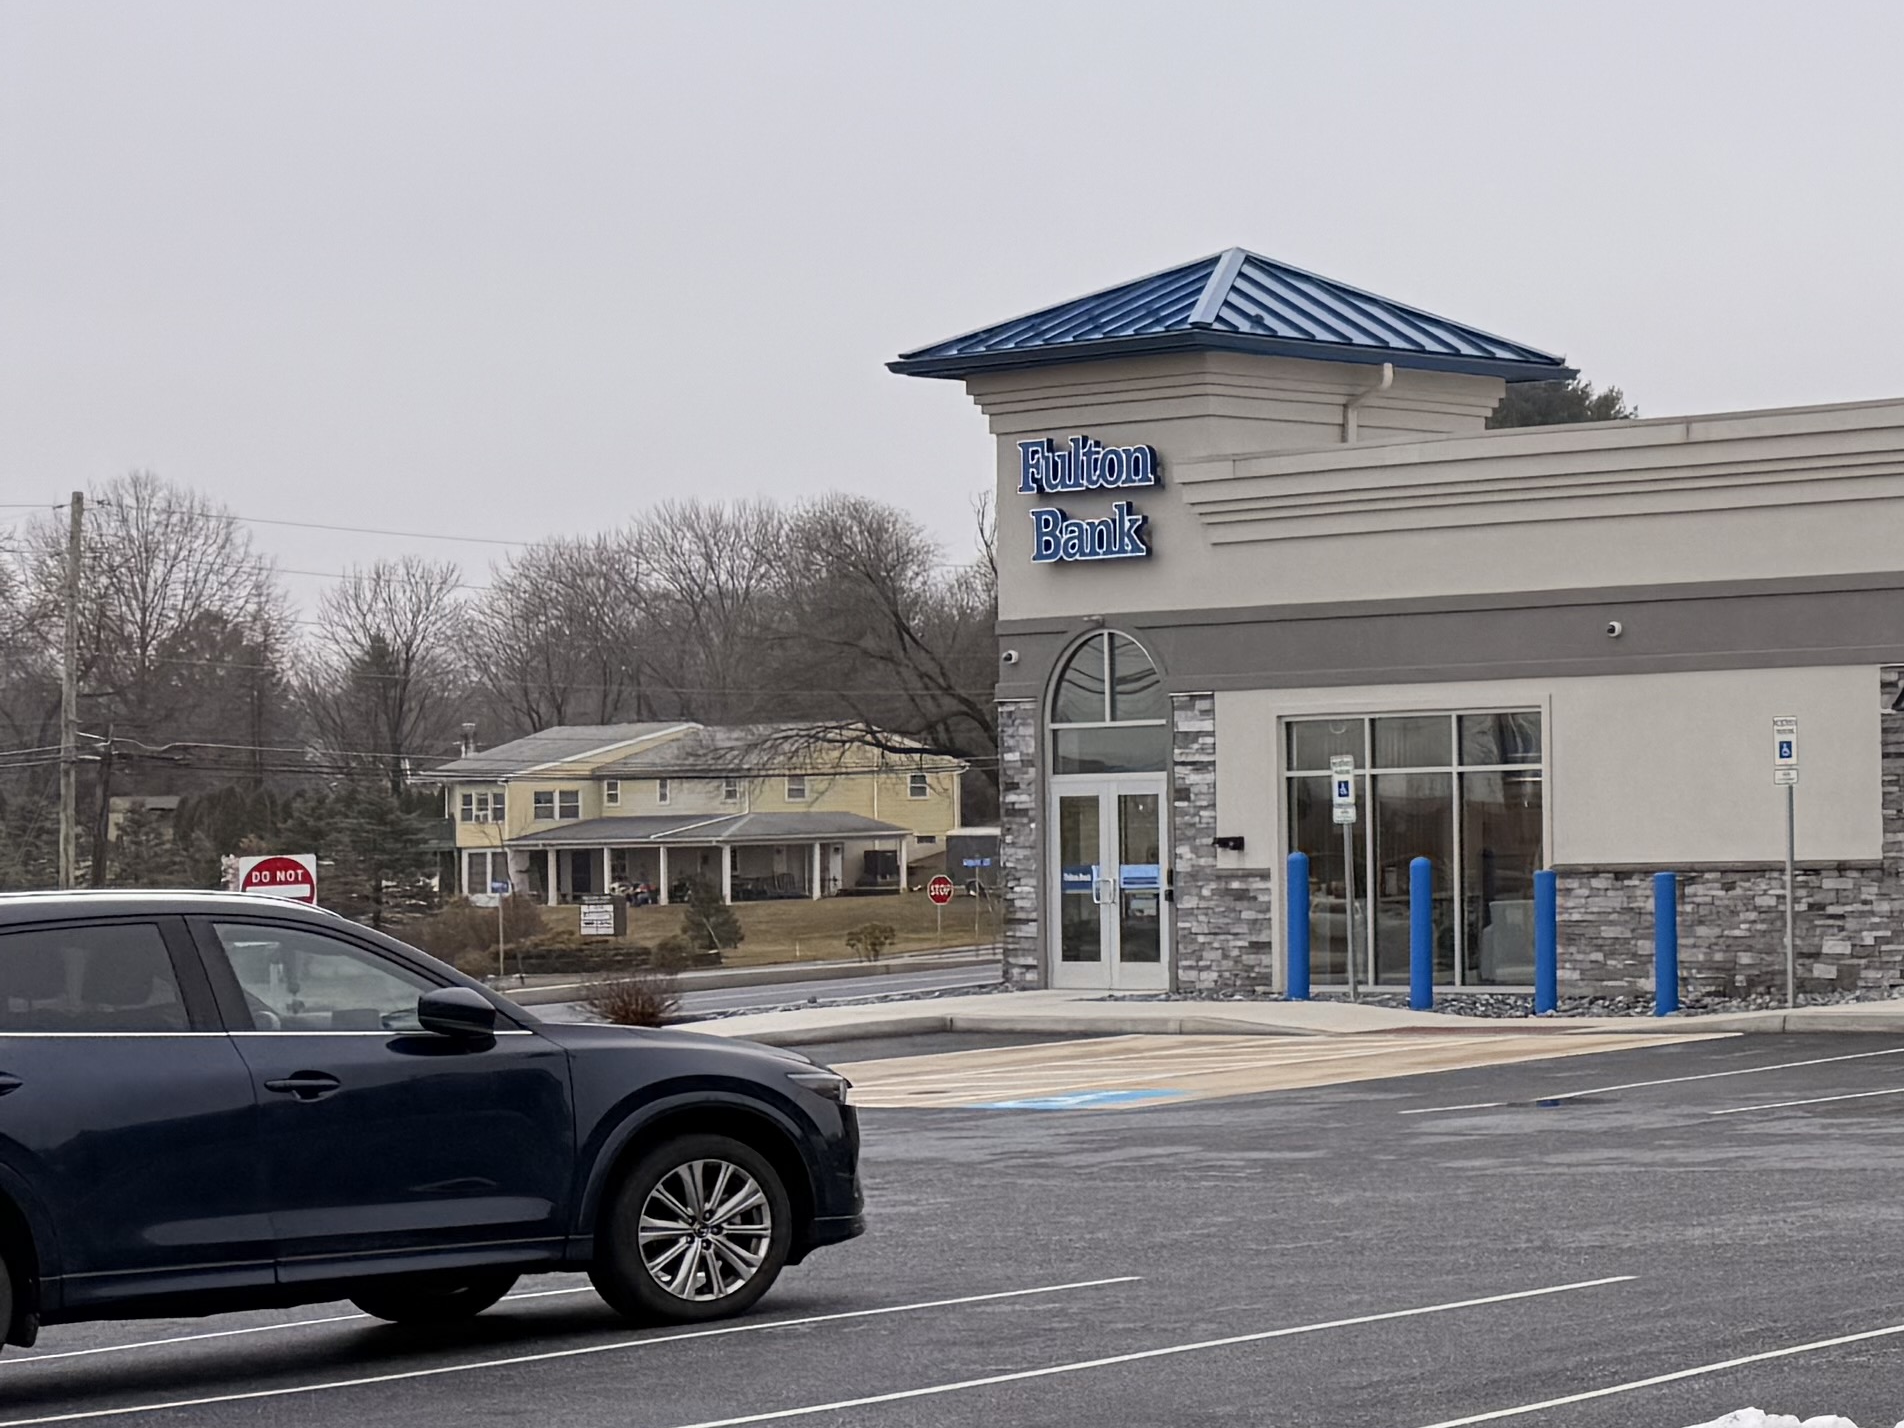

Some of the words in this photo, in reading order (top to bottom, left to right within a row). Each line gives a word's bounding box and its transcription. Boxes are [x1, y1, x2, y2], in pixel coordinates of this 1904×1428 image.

[1017, 435, 1156, 494] Fulton
[1029, 501, 1148, 563] Bank
[251, 871, 270, 883] DO
[276, 869, 304, 882] NOT
